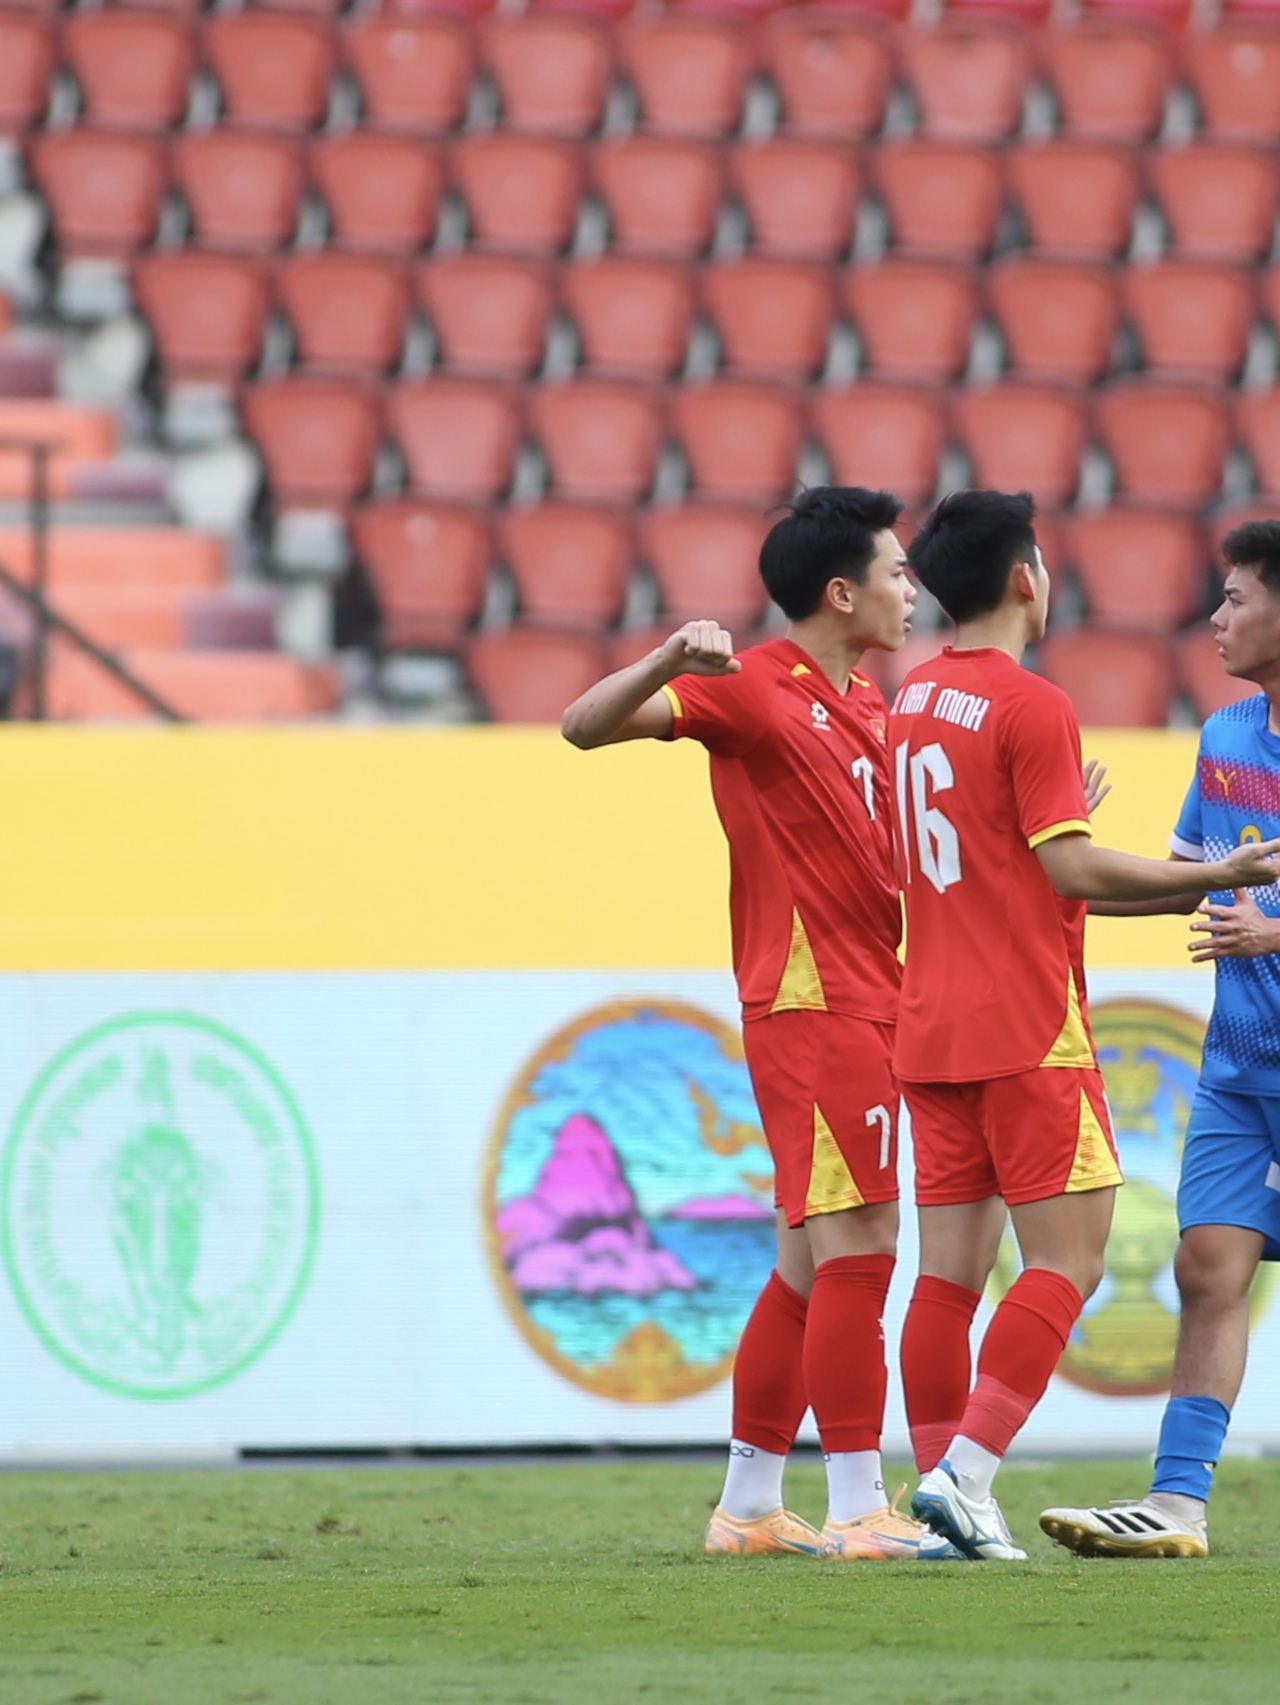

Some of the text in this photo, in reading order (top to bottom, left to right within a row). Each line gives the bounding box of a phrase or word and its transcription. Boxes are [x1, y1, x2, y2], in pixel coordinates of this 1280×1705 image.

[932, 688, 990, 732] MINH
[851, 755, 876, 821] 7
[895, 738, 963, 895] 16
[864, 1103, 891, 1170] 7
